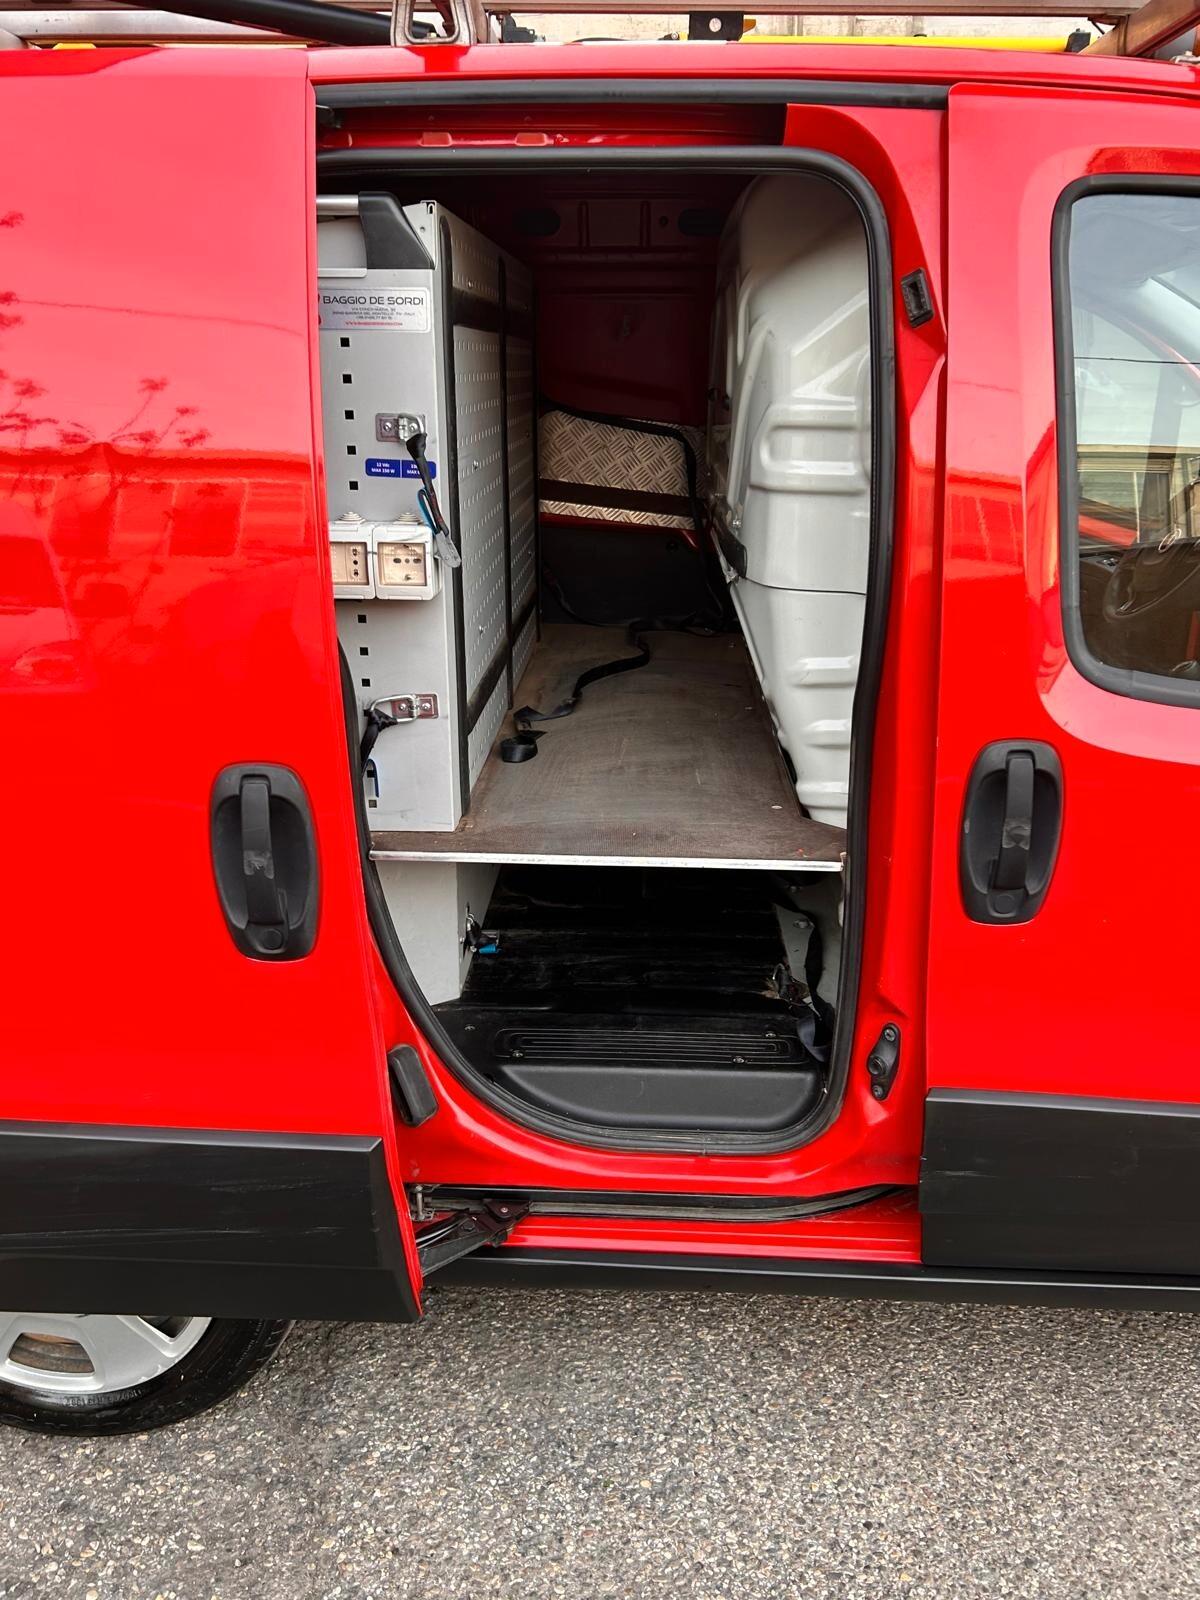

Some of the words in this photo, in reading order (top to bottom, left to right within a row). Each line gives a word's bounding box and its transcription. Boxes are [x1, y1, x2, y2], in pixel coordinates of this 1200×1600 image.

[322, 295, 367, 305] BAGGIO
[369, 296, 385, 305] DE
[387, 296, 424, 306] SORDI
